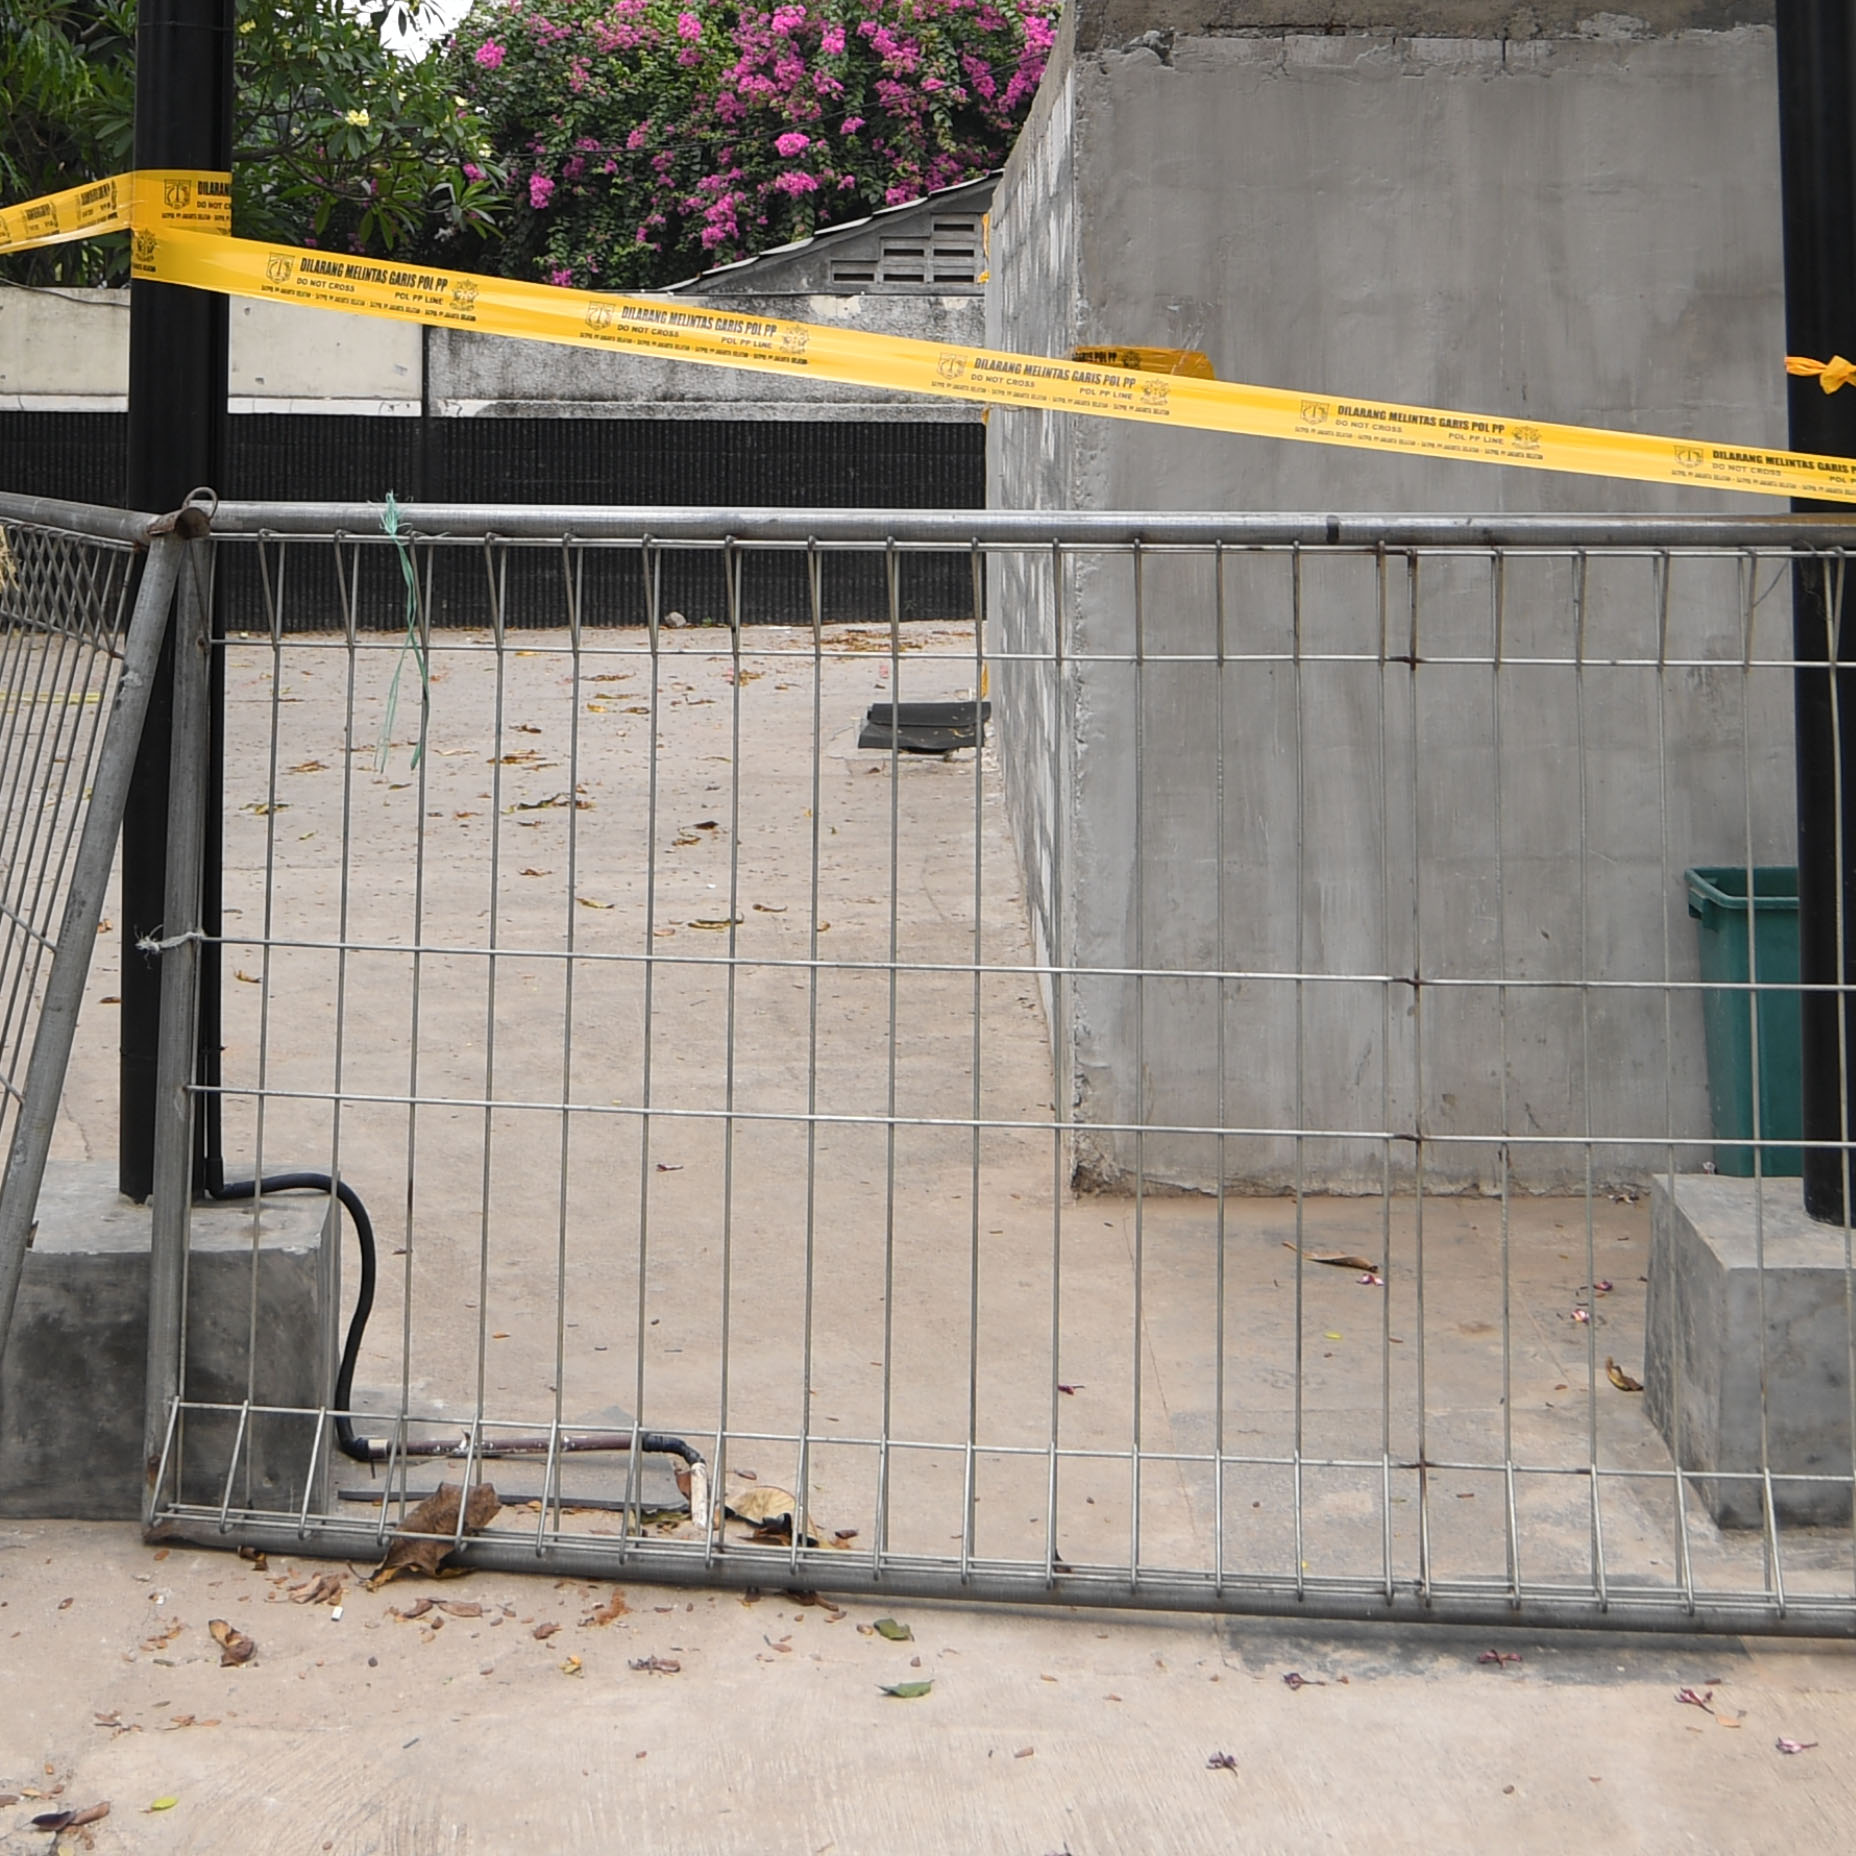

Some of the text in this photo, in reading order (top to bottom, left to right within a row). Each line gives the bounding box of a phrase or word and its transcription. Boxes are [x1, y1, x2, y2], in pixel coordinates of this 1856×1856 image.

[300, 257, 448, 292] DILARANG MELINTAS GARIS POL PP
[297, 278, 355, 292] DO NOT CROSS
[395, 292, 444, 305] POL PP LINE
[622, 306, 777, 337] DILARANG MELINTAS GARIS POL PP
[617, 324, 679, 338] DO NOT CROSS
[721, 337, 737, 345] POL
[753, 341, 773, 349] LINE
[974, 358, 1136, 388] DILARANG MELINTAS GARIS POL PP
[986, 376, 1004, 384] NOT
[1006, 379, 1035, 387] CROSS
[1113, 391, 1133, 400] LINE
[1338, 405, 1505, 434] DILARANG MELINTAS GARIS POL PP
